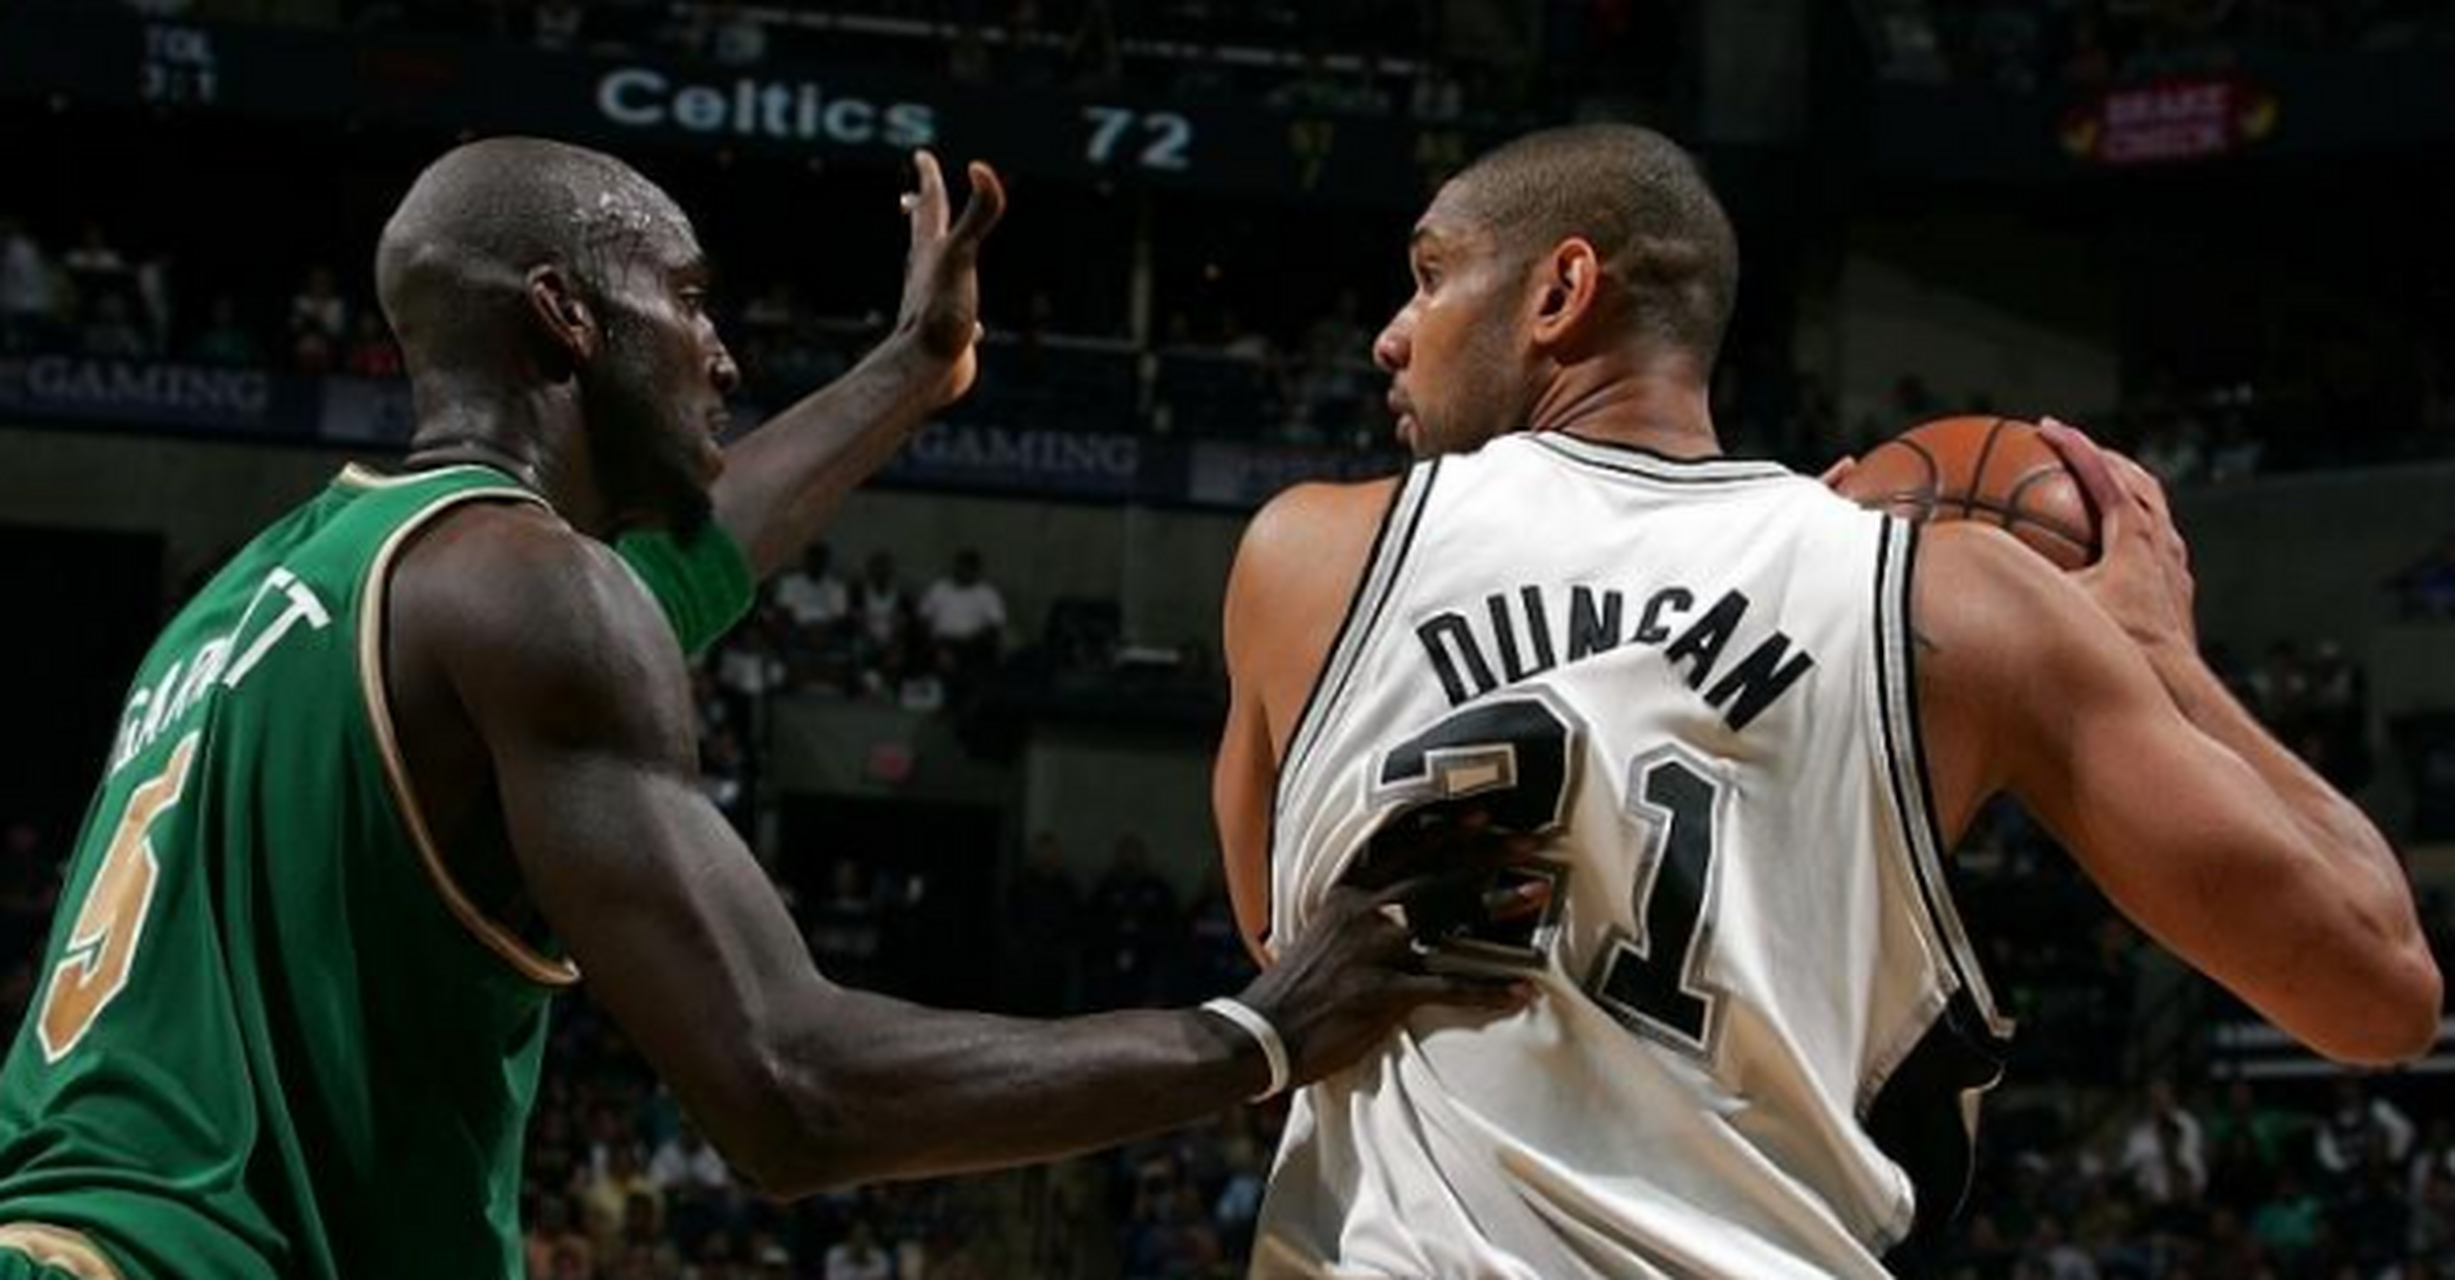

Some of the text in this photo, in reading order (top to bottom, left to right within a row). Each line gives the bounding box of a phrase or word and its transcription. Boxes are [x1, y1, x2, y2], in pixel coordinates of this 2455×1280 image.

[598, 68, 934, 147] Celtics
[1082, 104, 1194, 172] 72
[25, 352, 270, 412] GAMING
[908, 424, 1140, 475] GAMING
[1416, 586, 1815, 732] DUNCAN
[37, 729, 200, 1064] 5
[1367, 683, 1732, 1066] 21
